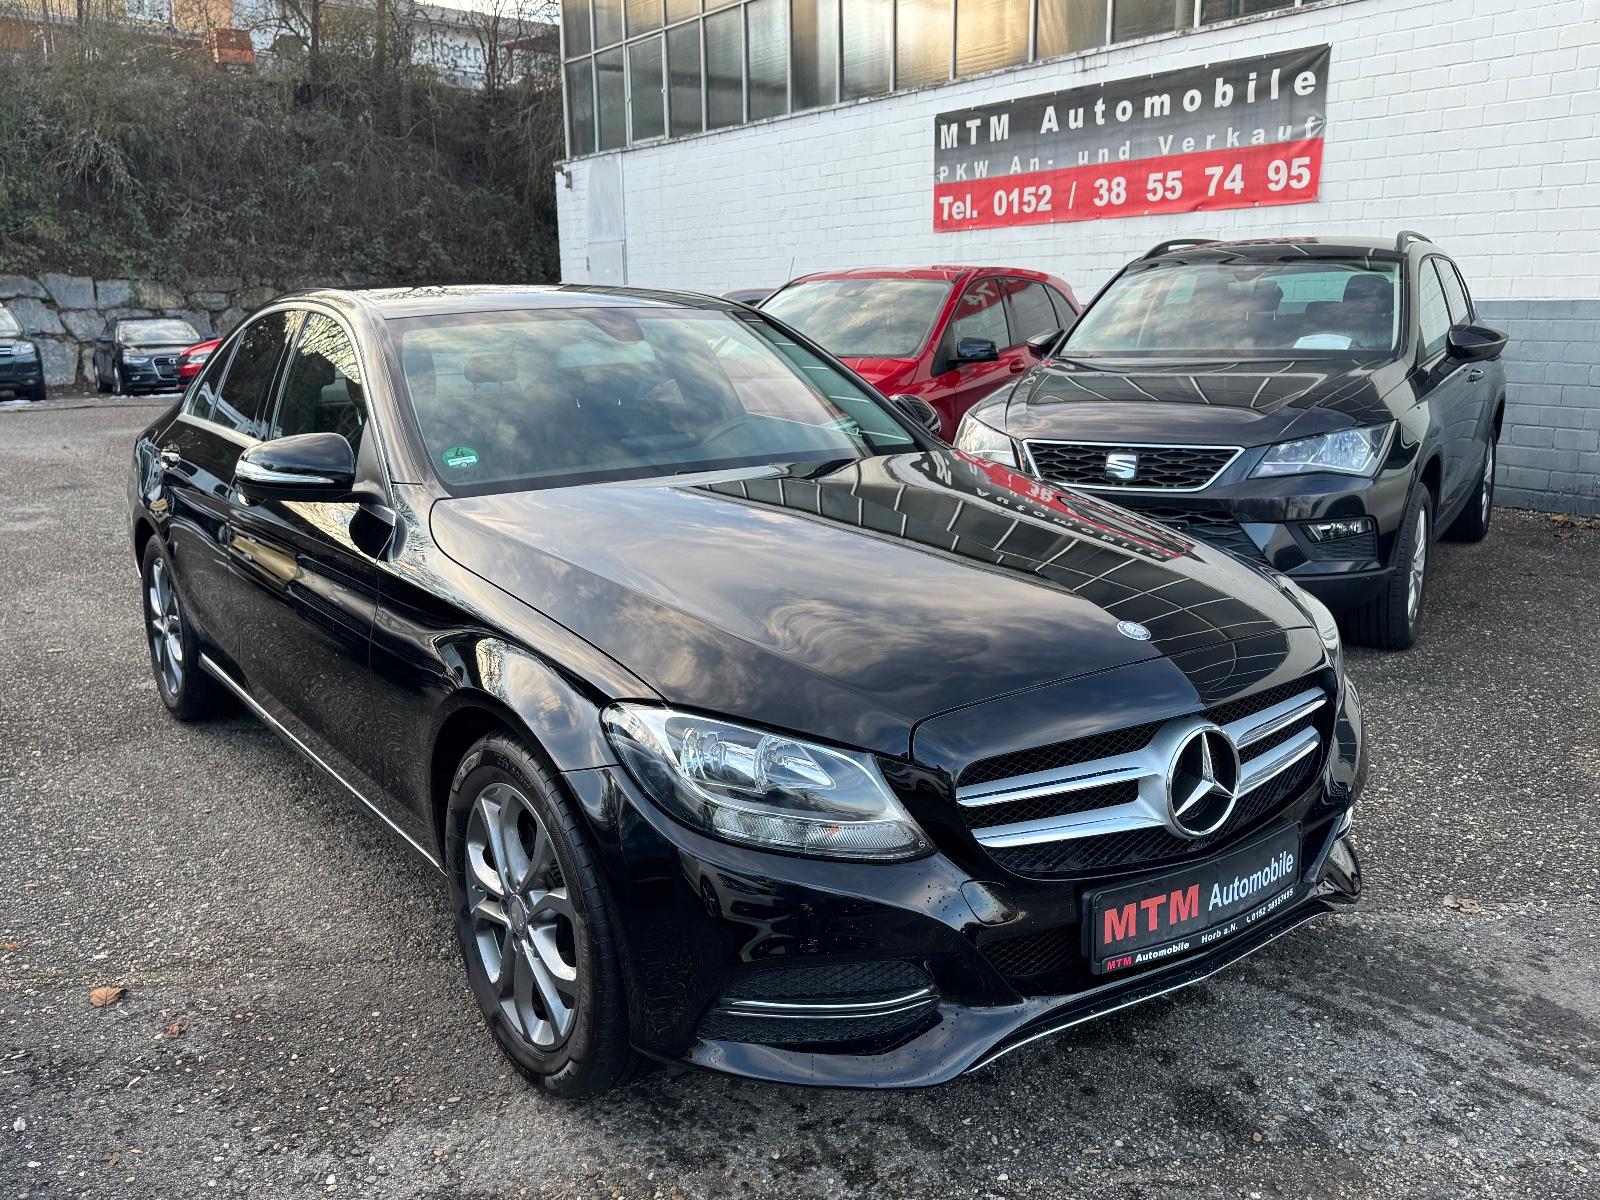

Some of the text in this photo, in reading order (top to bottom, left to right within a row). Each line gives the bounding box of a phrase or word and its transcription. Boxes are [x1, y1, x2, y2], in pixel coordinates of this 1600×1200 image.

[940, 69, 1317, 150] MTM Automobile
[939, 116, 1315, 182] PKW An- und Verkauf
[939, 157, 1312, 221] Tel. 0152 / 38 55 74 95
[1104, 850, 1294, 945] MTM Automobile
[1106, 956, 1132, 971] MTM
[1135, 941, 1190, 963] Automobile
[1201, 929, 1222, 944] Horb
[1251, 906, 1267, 921] 0152
